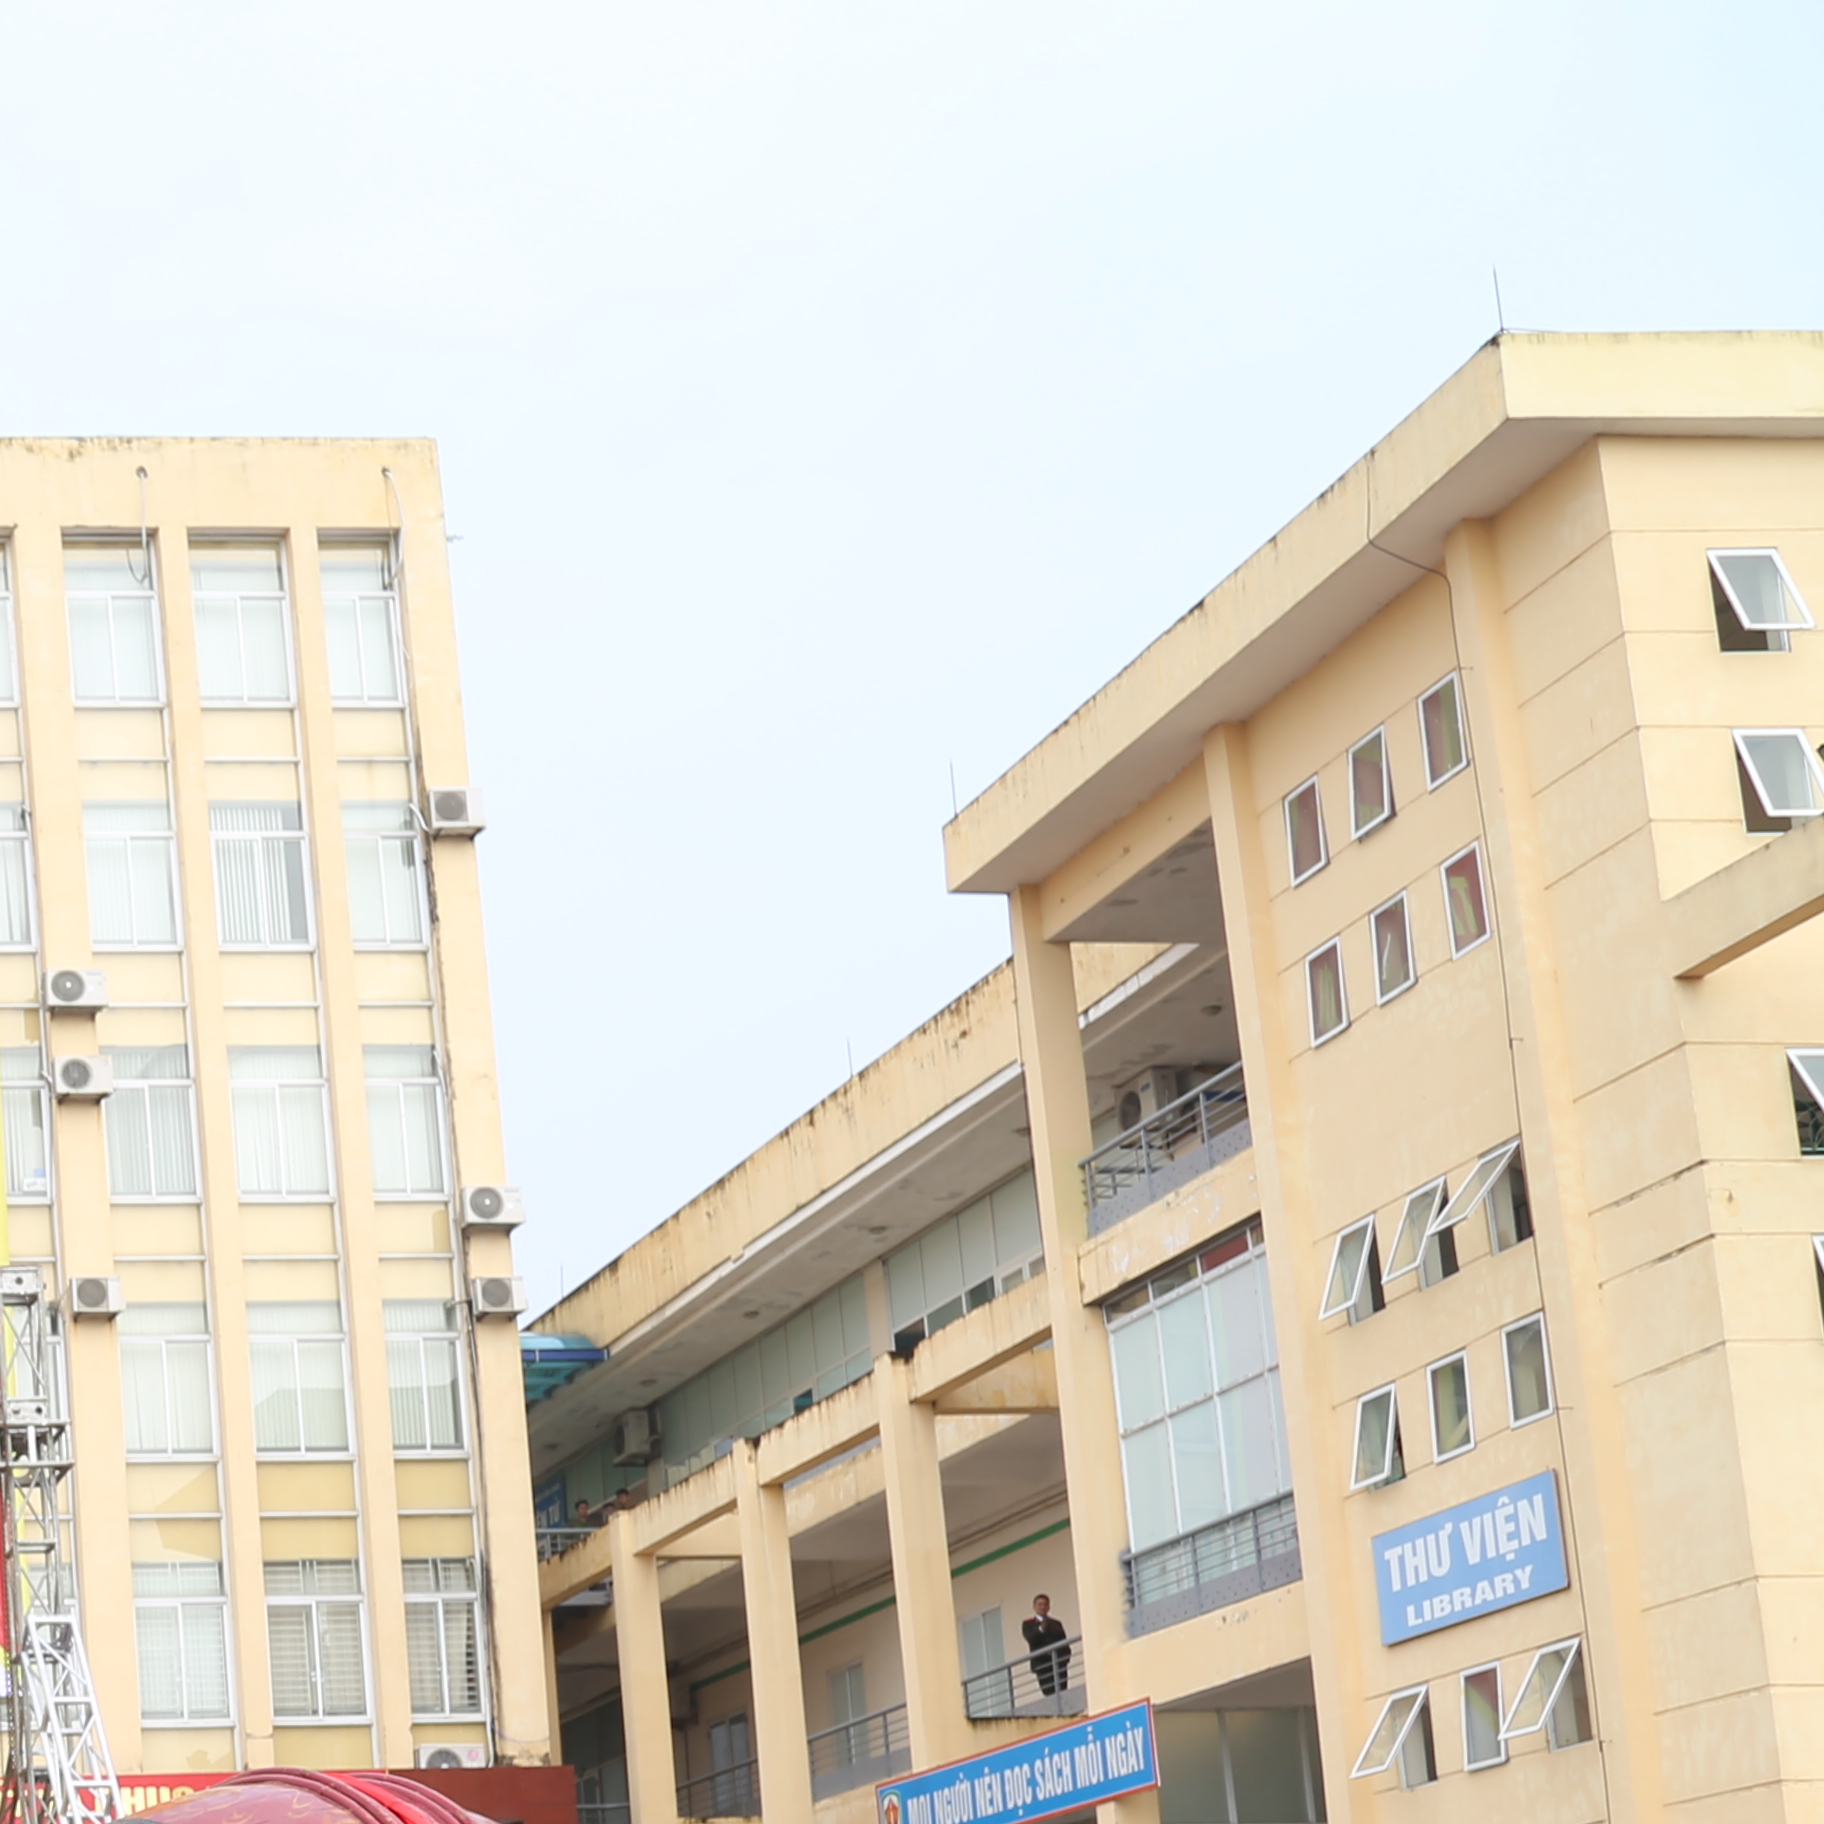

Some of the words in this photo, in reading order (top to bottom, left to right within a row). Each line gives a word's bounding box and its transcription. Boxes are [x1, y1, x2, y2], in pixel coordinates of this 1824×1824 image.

[1384, 1522, 1453, 1592] THƯ
[1459, 1494, 1547, 1566] VIỆN
[1406, 1564, 1533, 1627] LIBRARY
[975, 1767, 1003, 1816] NÊN
[1005, 1763, 1032, 1815] ĐỌC
[1034, 1748, 1073, 1800] SÁCH
[1074, 1726, 1104, 1788] MỖI
[1105, 1721, 1145, 1780] NGÀY
